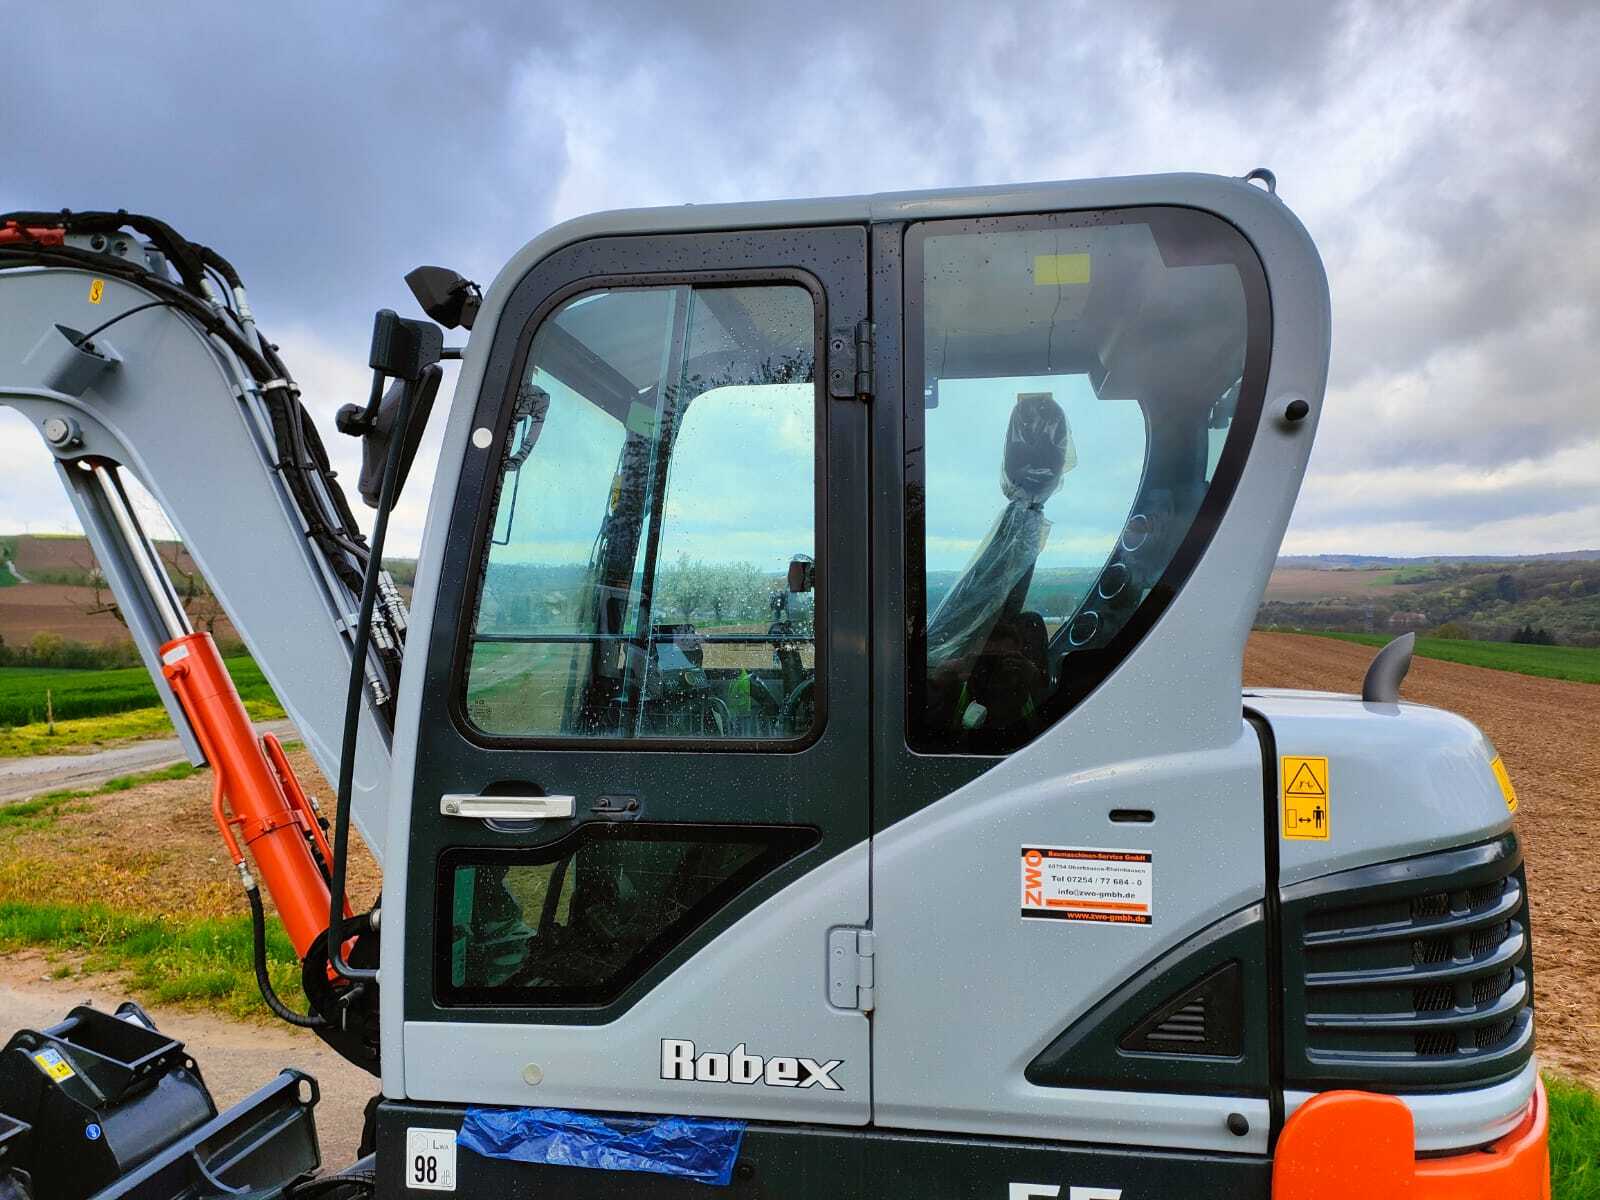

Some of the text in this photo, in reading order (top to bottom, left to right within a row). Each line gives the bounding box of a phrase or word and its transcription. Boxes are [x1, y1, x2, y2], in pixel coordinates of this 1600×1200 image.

[1066, 876, 1093, 885] 07254
[1113, 878, 1129, 886] 684
[1067, 912, 1146, 923] www.zwo-gmbh.de
[660, 1037, 846, 1092] Robex
[414, 1155, 437, 1183] 98
